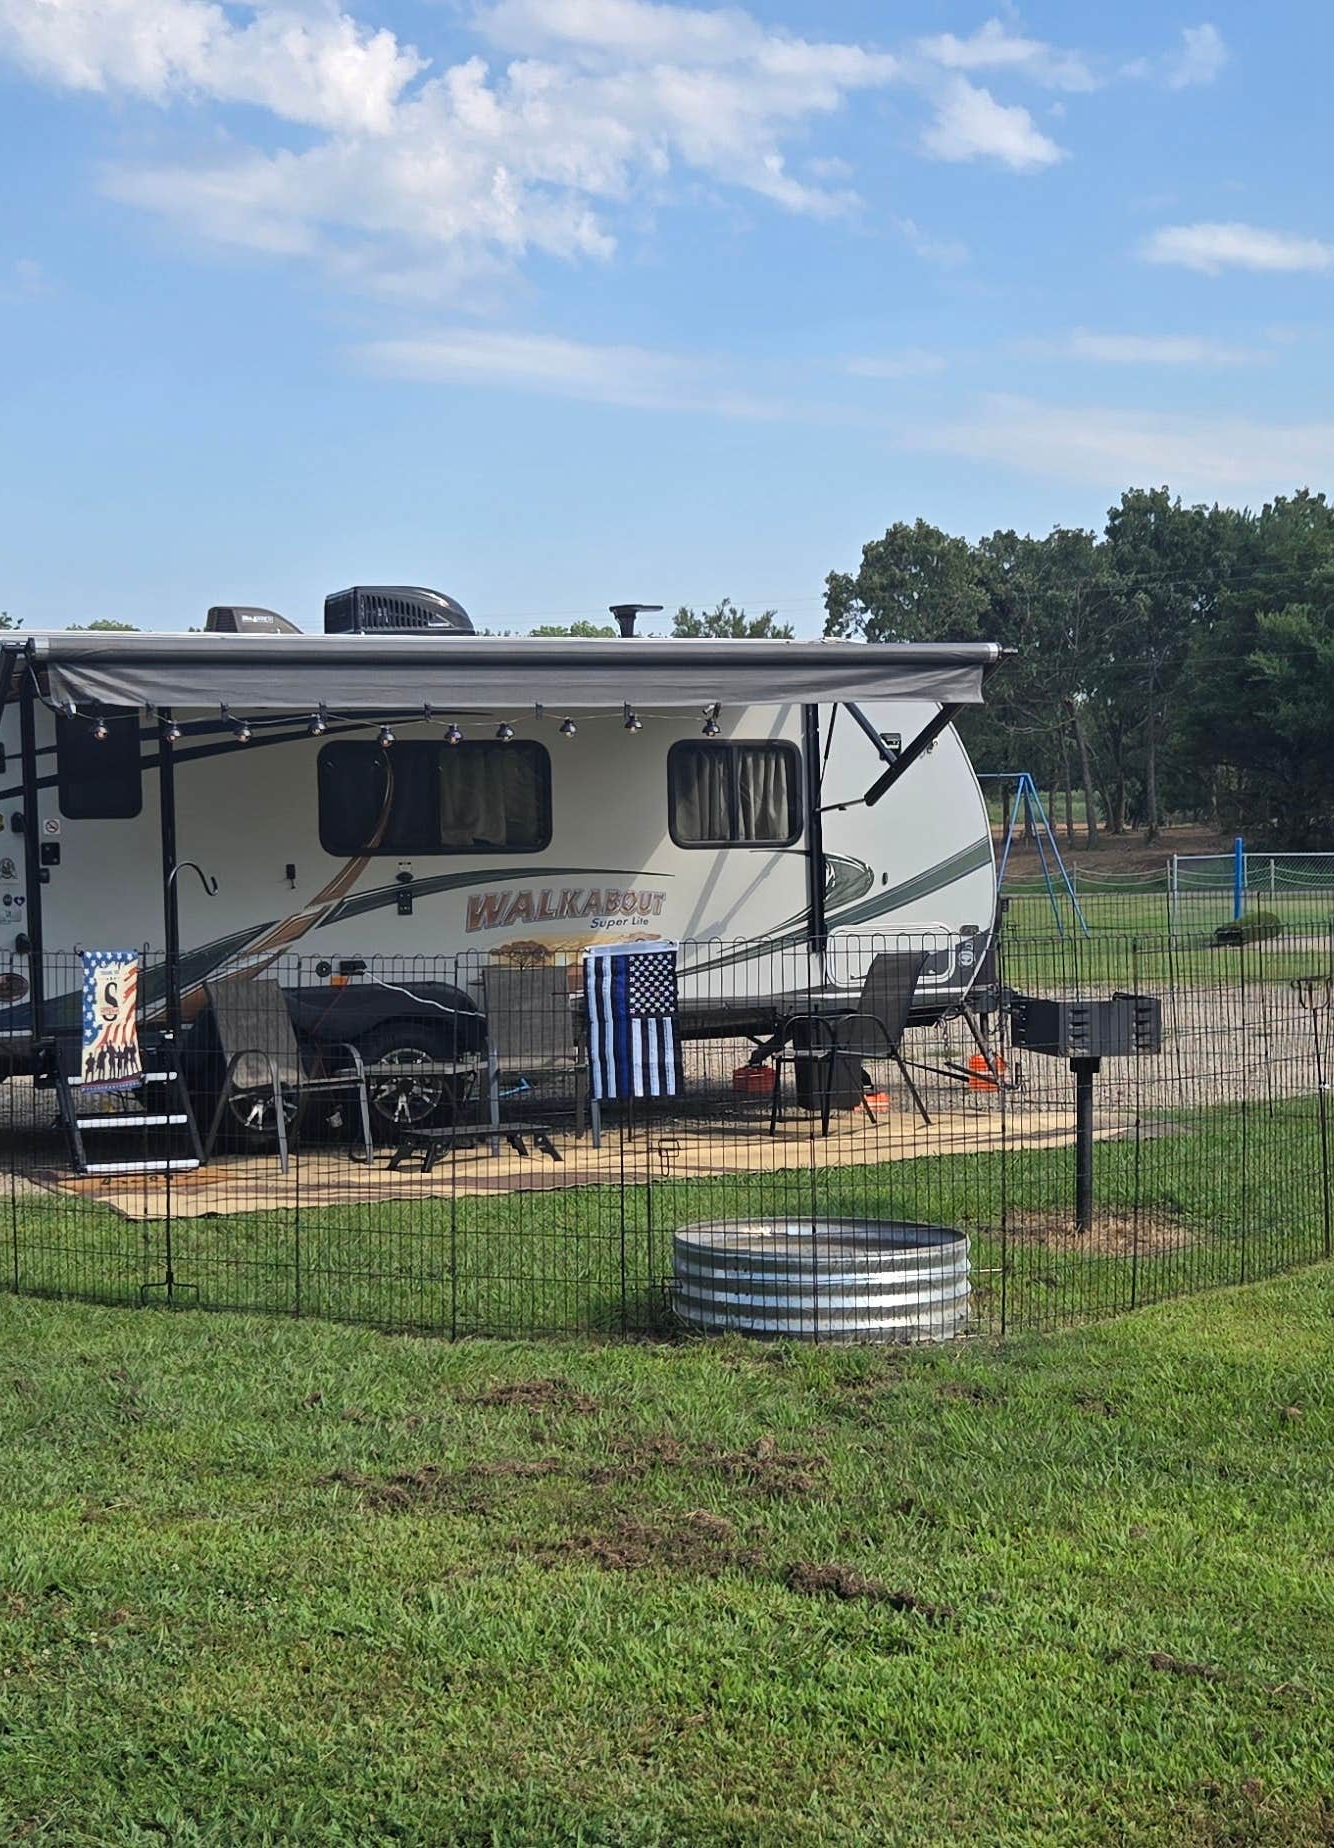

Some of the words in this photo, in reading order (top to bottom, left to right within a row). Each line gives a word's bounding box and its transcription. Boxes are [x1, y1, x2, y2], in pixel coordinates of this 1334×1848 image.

[465, 887, 666, 933] WALKABOUT
[590, 917, 628, 930] Super
[631, 916, 649, 926] Lite
